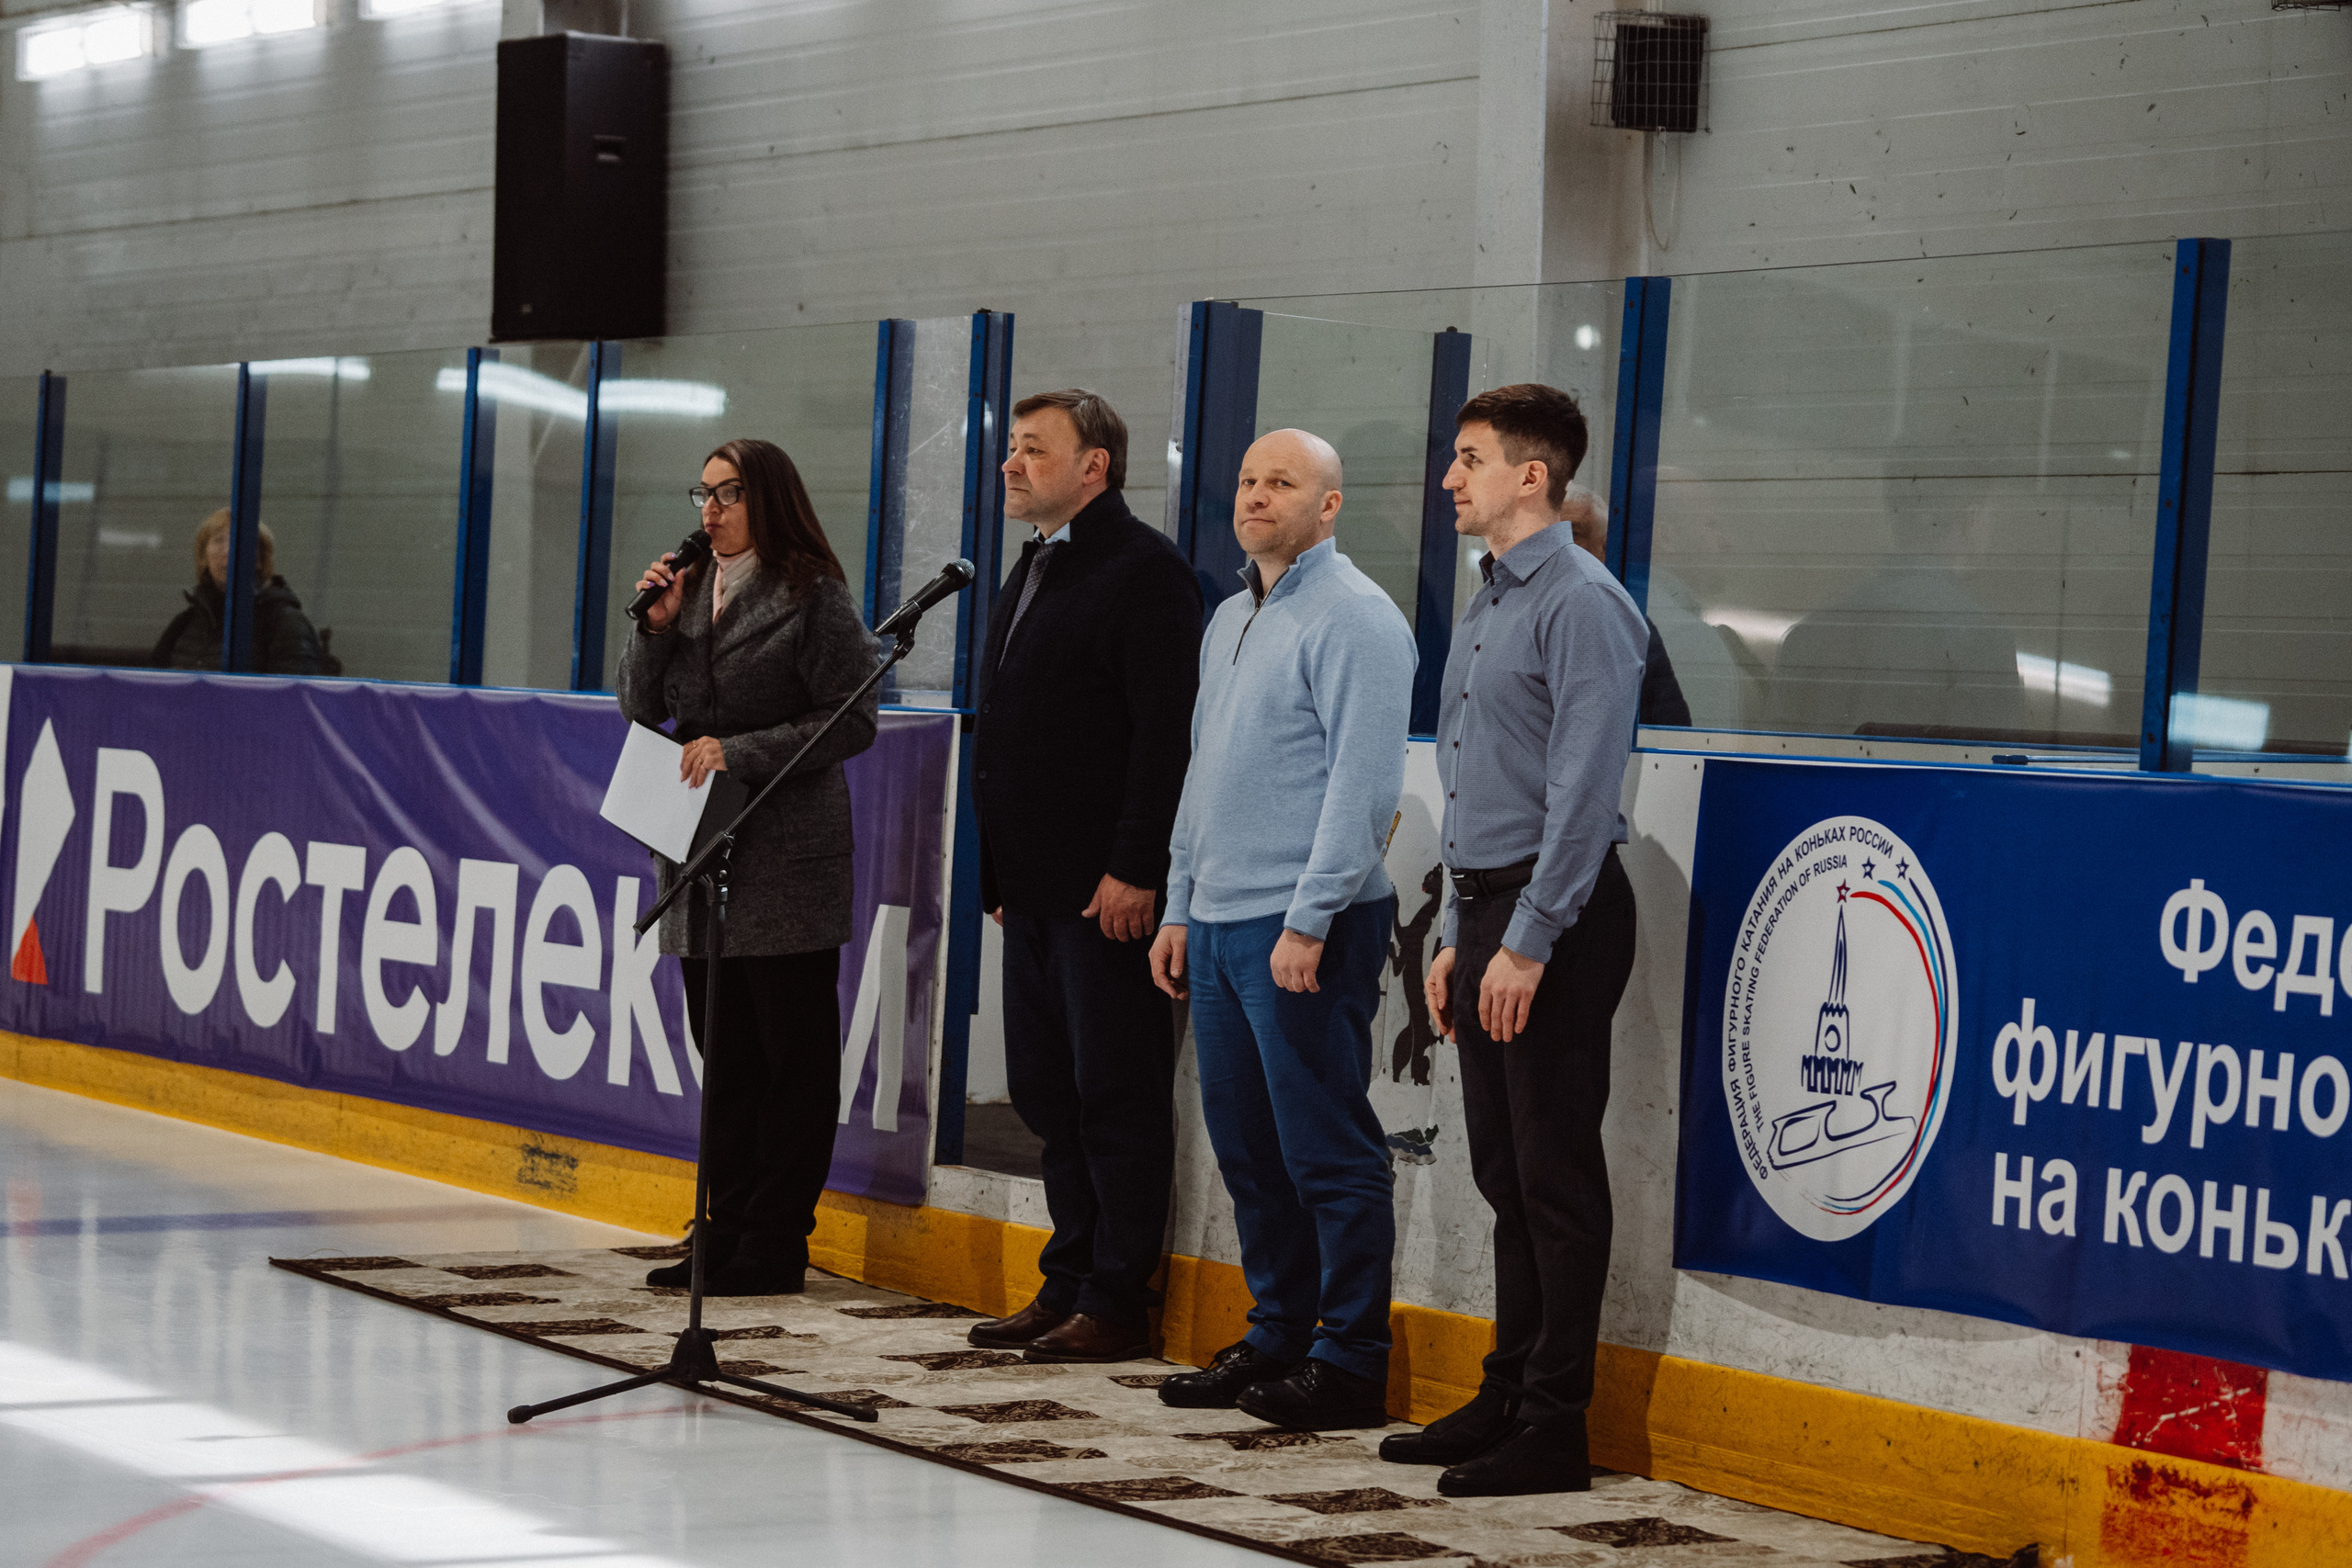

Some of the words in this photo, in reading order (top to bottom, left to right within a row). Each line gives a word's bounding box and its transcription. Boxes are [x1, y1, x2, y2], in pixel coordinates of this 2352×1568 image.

[1777, 856, 1794, 879] НА
[1794, 826, 1846, 862] КОНЬКАХ
[1798, 867, 1812, 887] OF
[1813, 854, 1848, 877] RUSSIA
[1849, 826, 1894, 859] РОССИИ
[85, 747, 910, 1133] Ростелекм
[1741, 875, 1778, 952] КАТАНИЯ
[1754, 880, 1799, 964] FEDERATION
[2160, 878, 2352, 1017] Фед
[1728, 956, 1746, 1072] ФИГУРНОГО
[1742, 966, 1759, 1035] SKATING
[1742, 1041, 1758, 1100] FIGURE
[1992, 998, 2351, 1148] фигурно
[1730, 1078, 1769, 1180] ФЕДЕРАЦИЯ
[1752, 1100, 1764, 1134] THE
[1991, 1151, 2077, 1236] на
[2104, 1168, 2352, 1280] коньк
